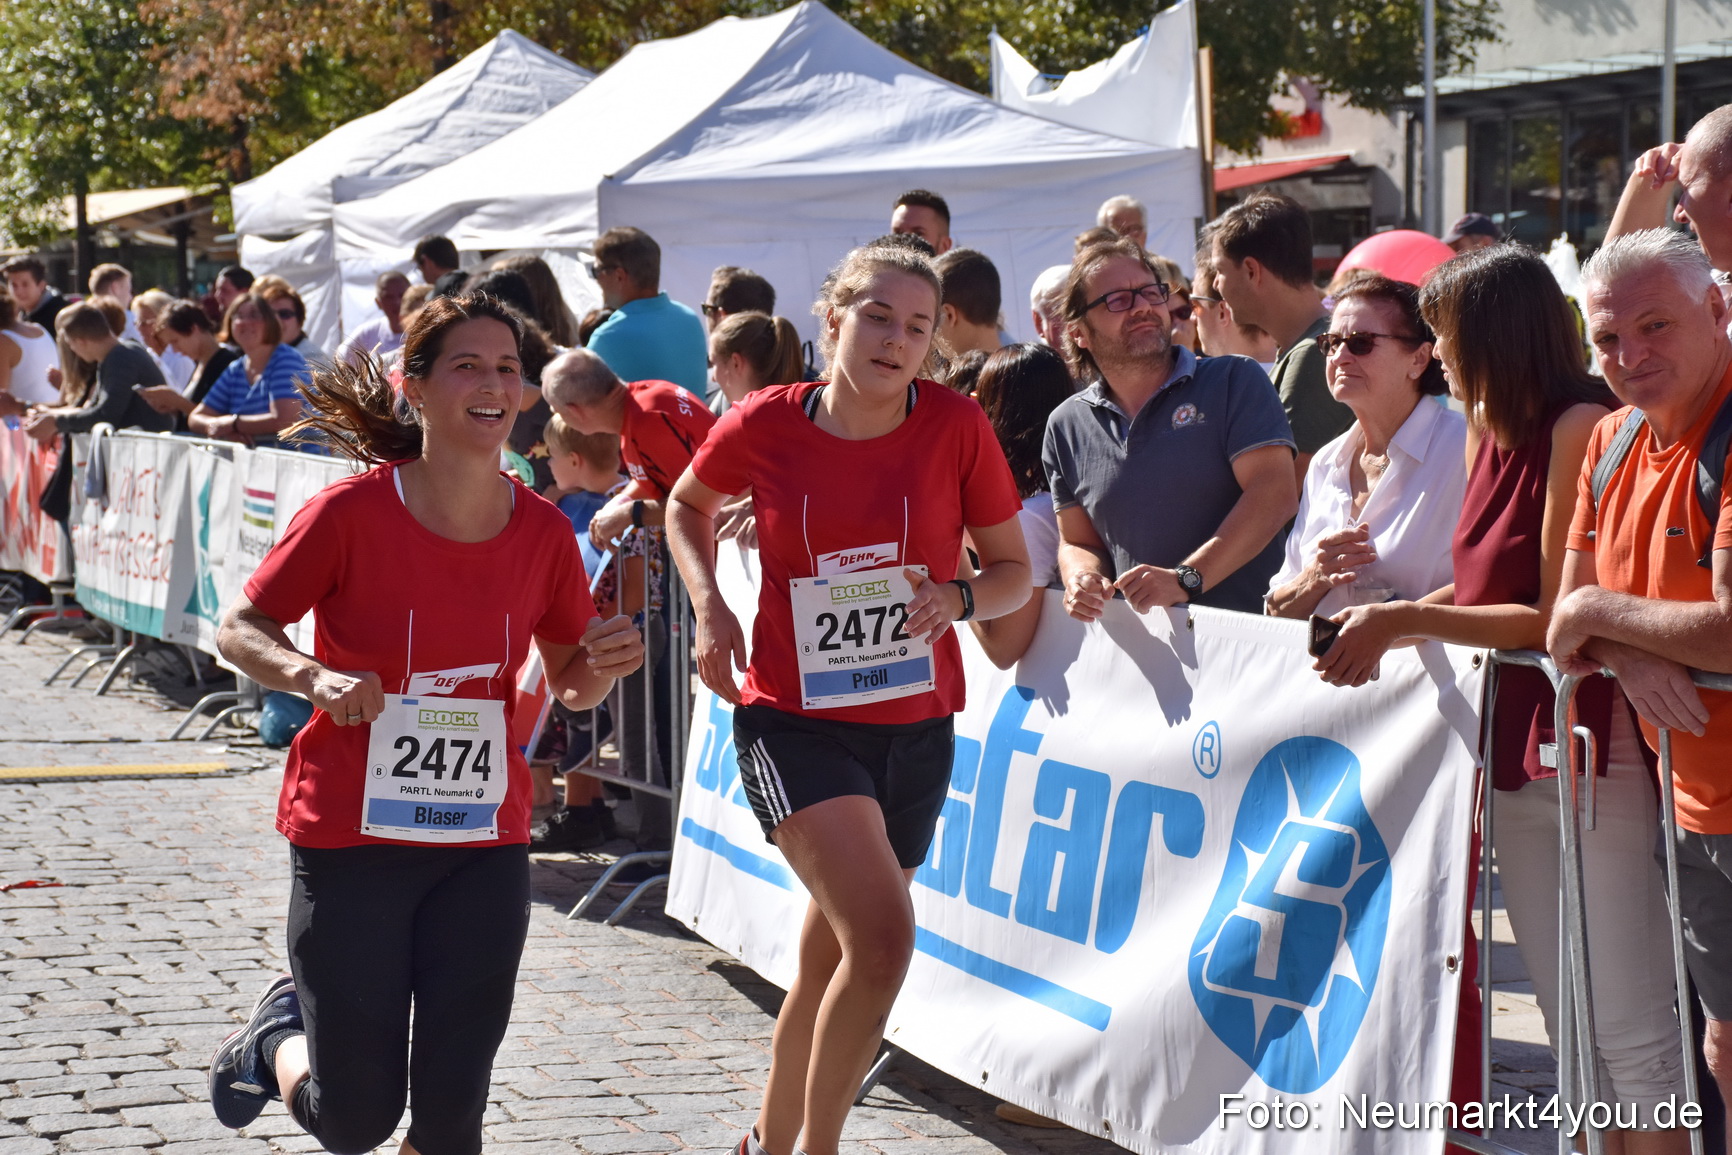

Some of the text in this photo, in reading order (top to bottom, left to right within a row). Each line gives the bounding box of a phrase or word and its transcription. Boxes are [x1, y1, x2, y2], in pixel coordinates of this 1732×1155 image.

[839, 552, 876, 568] DEHN
[831, 580, 891, 601] BOCK
[815, 603, 910, 652] 2472
[804, 645, 811, 653] B
[828, 649, 897, 665] PARTL Neumarkt
[852, 668, 889, 689] Pröll
[419, 709, 479, 727] BOCK
[391, 735, 492, 782] 2474
[375, 767, 382, 776] B
[400, 785, 473, 798] PARTL Neumarkt
[413, 806, 468, 826] Blaser
